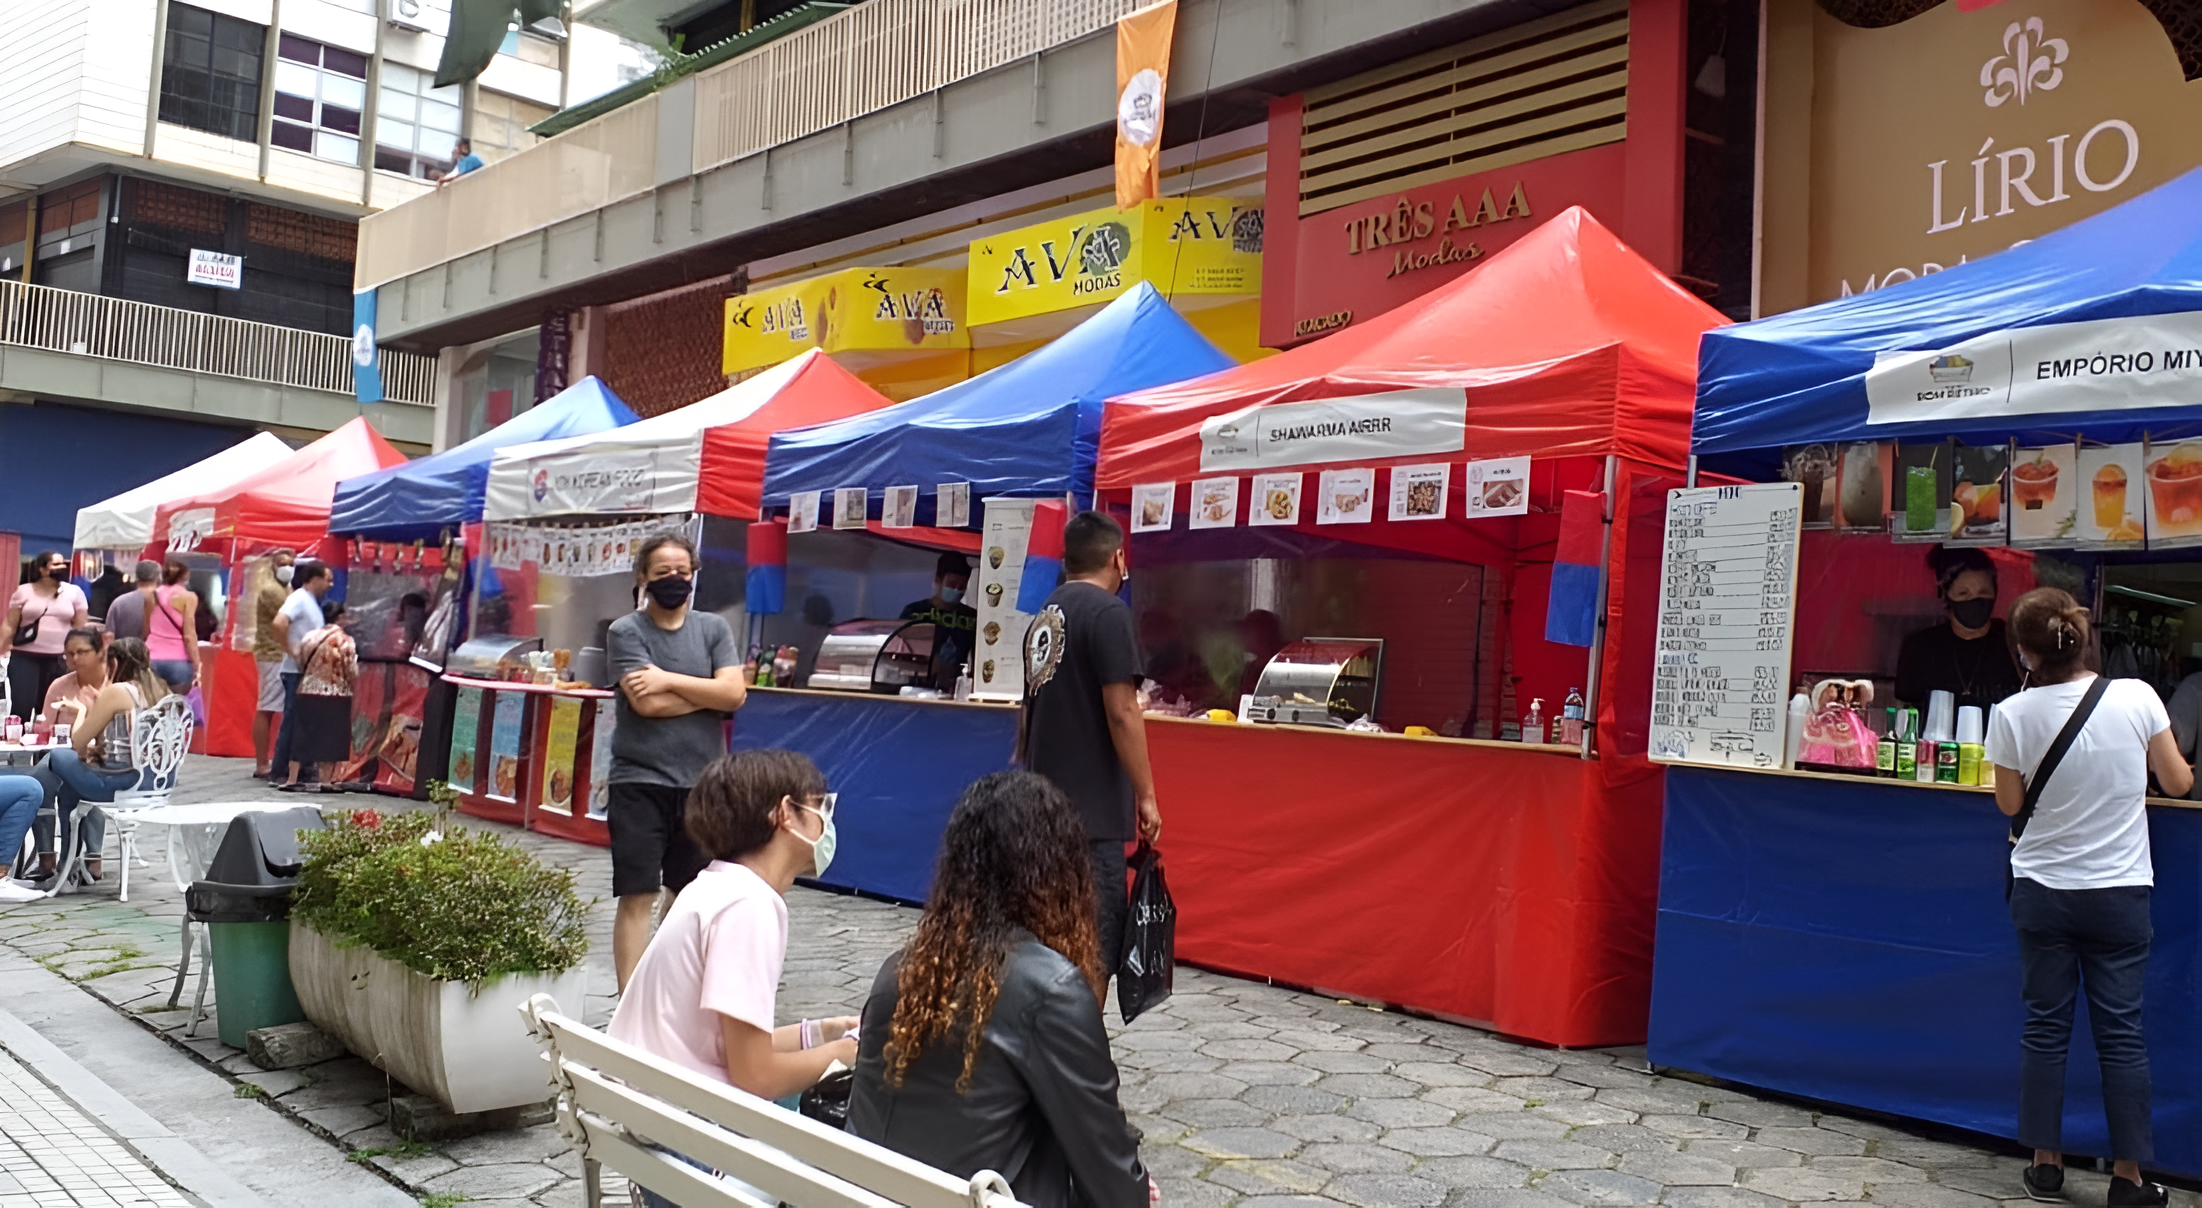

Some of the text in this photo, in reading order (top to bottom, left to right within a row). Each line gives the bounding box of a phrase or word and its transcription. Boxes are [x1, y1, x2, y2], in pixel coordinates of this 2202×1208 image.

[1926, 119, 2140, 234] LÍRIO
[1345, 180, 1532, 255] TRÊS AAA
[1386, 239, 1486, 280] Modas
[1073, 273, 1121, 295] MODAS
[875, 290, 945, 321] AVA
[2036, 350, 2154, 380] EMPÓRIO
[1269, 421, 1346, 442] SHAWARMA
